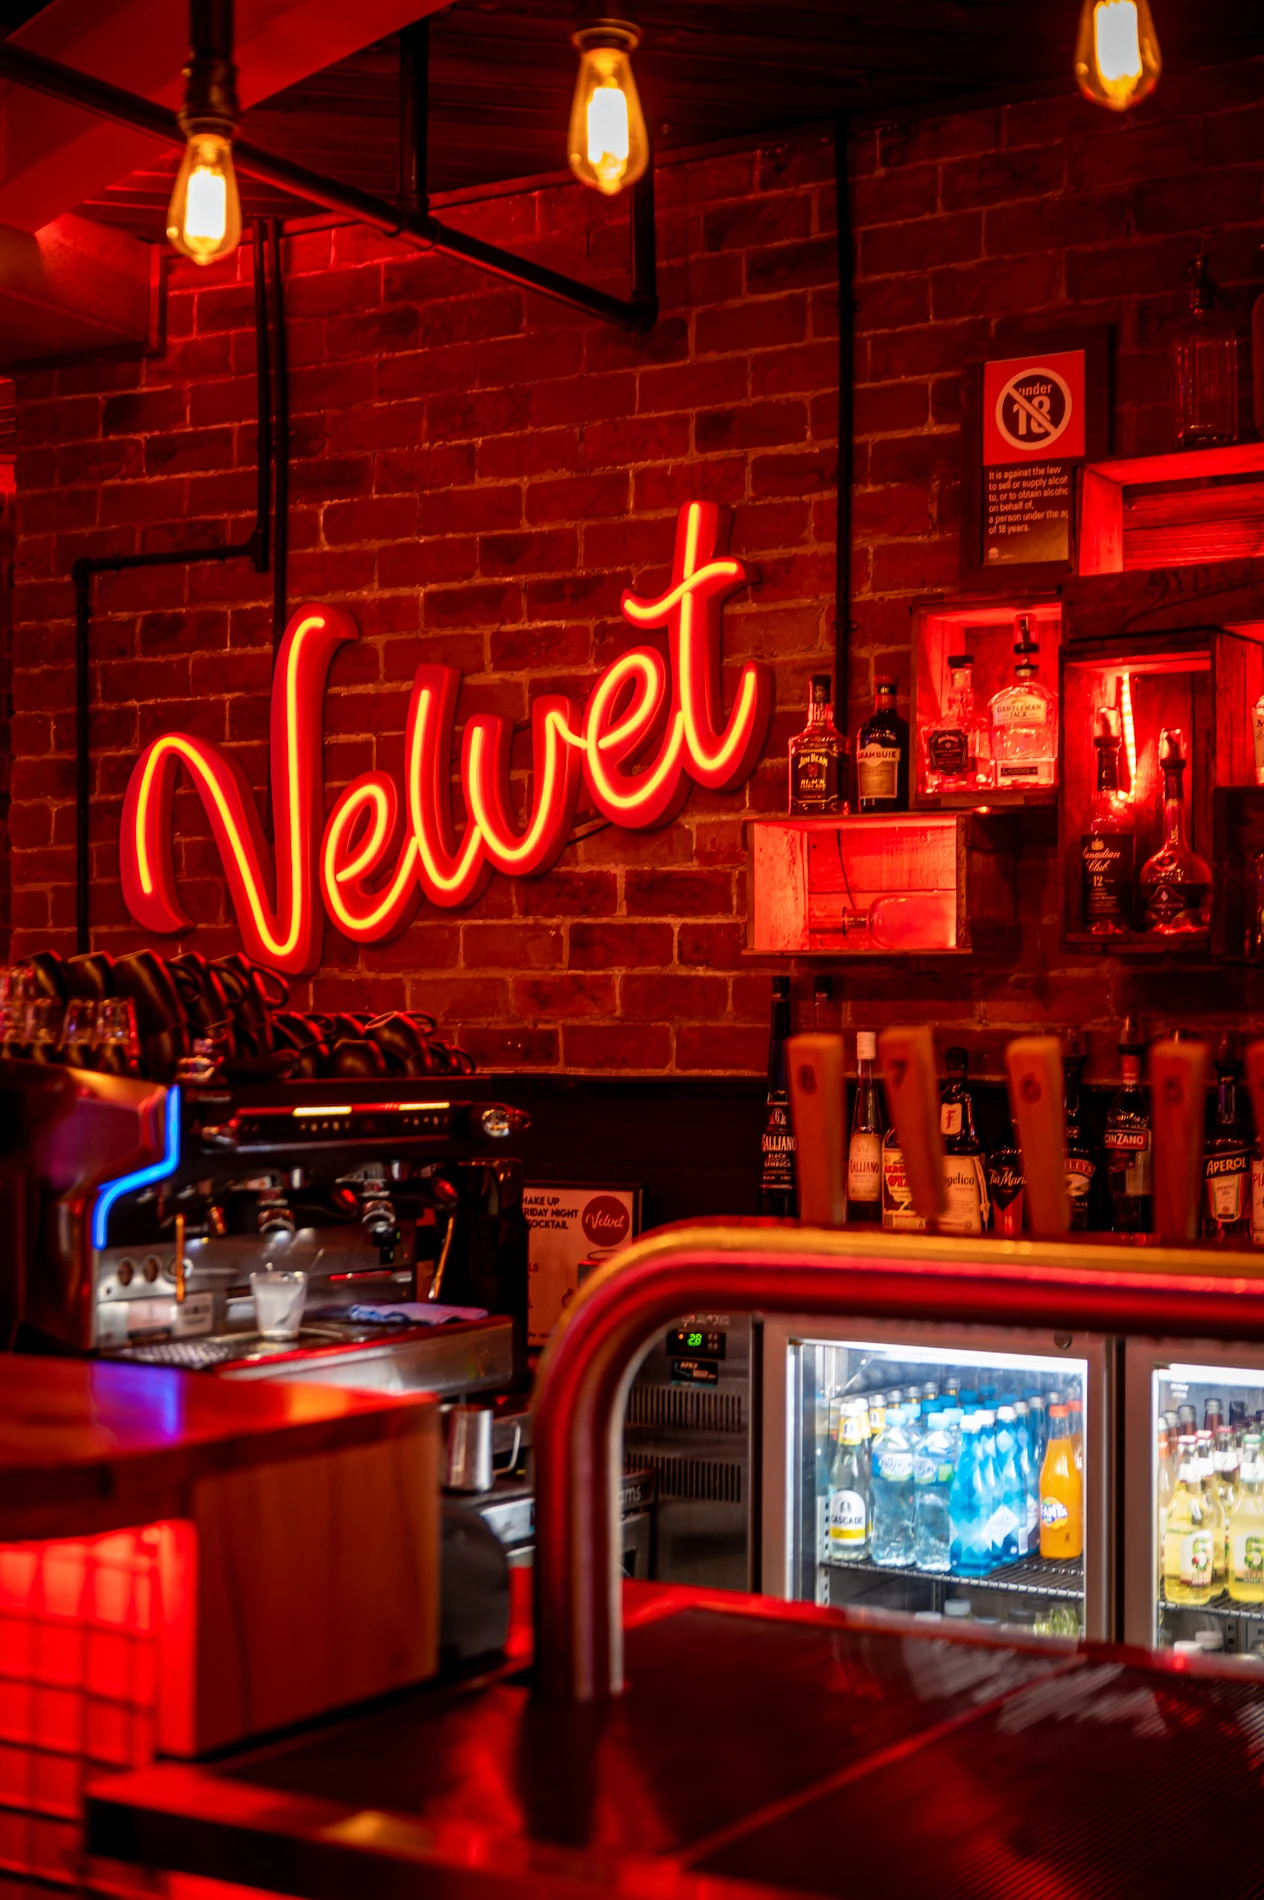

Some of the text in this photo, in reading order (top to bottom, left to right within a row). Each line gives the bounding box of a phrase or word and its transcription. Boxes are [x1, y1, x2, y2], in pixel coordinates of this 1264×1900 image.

[996, 470, 1002, 479] is
[1004, 467, 1031, 482] against
[1032, 466, 1045, 476] the
[1046, 465, 1062, 475] law
[989, 482, 997, 492] to
[999, 479, 1011, 491] sell
[1012, 481, 1021, 490] or
[1022, 477, 1047, 489] supply
[989, 494, 999, 503] to,
[1000, 493, 1008, 501] or
[1009, 491, 1017, 500] to
[1018, 489, 1042, 500] obtain
[989, 505, 999, 513] on
[1000, 500, 1024, 512] behalf
[989, 516, 994, 524] a
[995, 513, 1022, 525] person
[1023, 510, 1045, 522] under
[1046, 509, 1059, 520] the
[989, 523, 1031, 535] of 18 years.
[997, 703, 1042, 713] GENTLEMAN
[1010, 711, 1028, 719] JACK
[119, 501, 772, 973] Velvet
[1093, 875, 1104, 887] 12
[1105, 1132, 1145, 1145] CINZANO
[1206, 1157, 1247, 1176] APEROL
[547, 1197, 560, 1206] UP
[551, 1209, 579, 1218] NIGHT
[585, 1210, 625, 1229] Velvet
